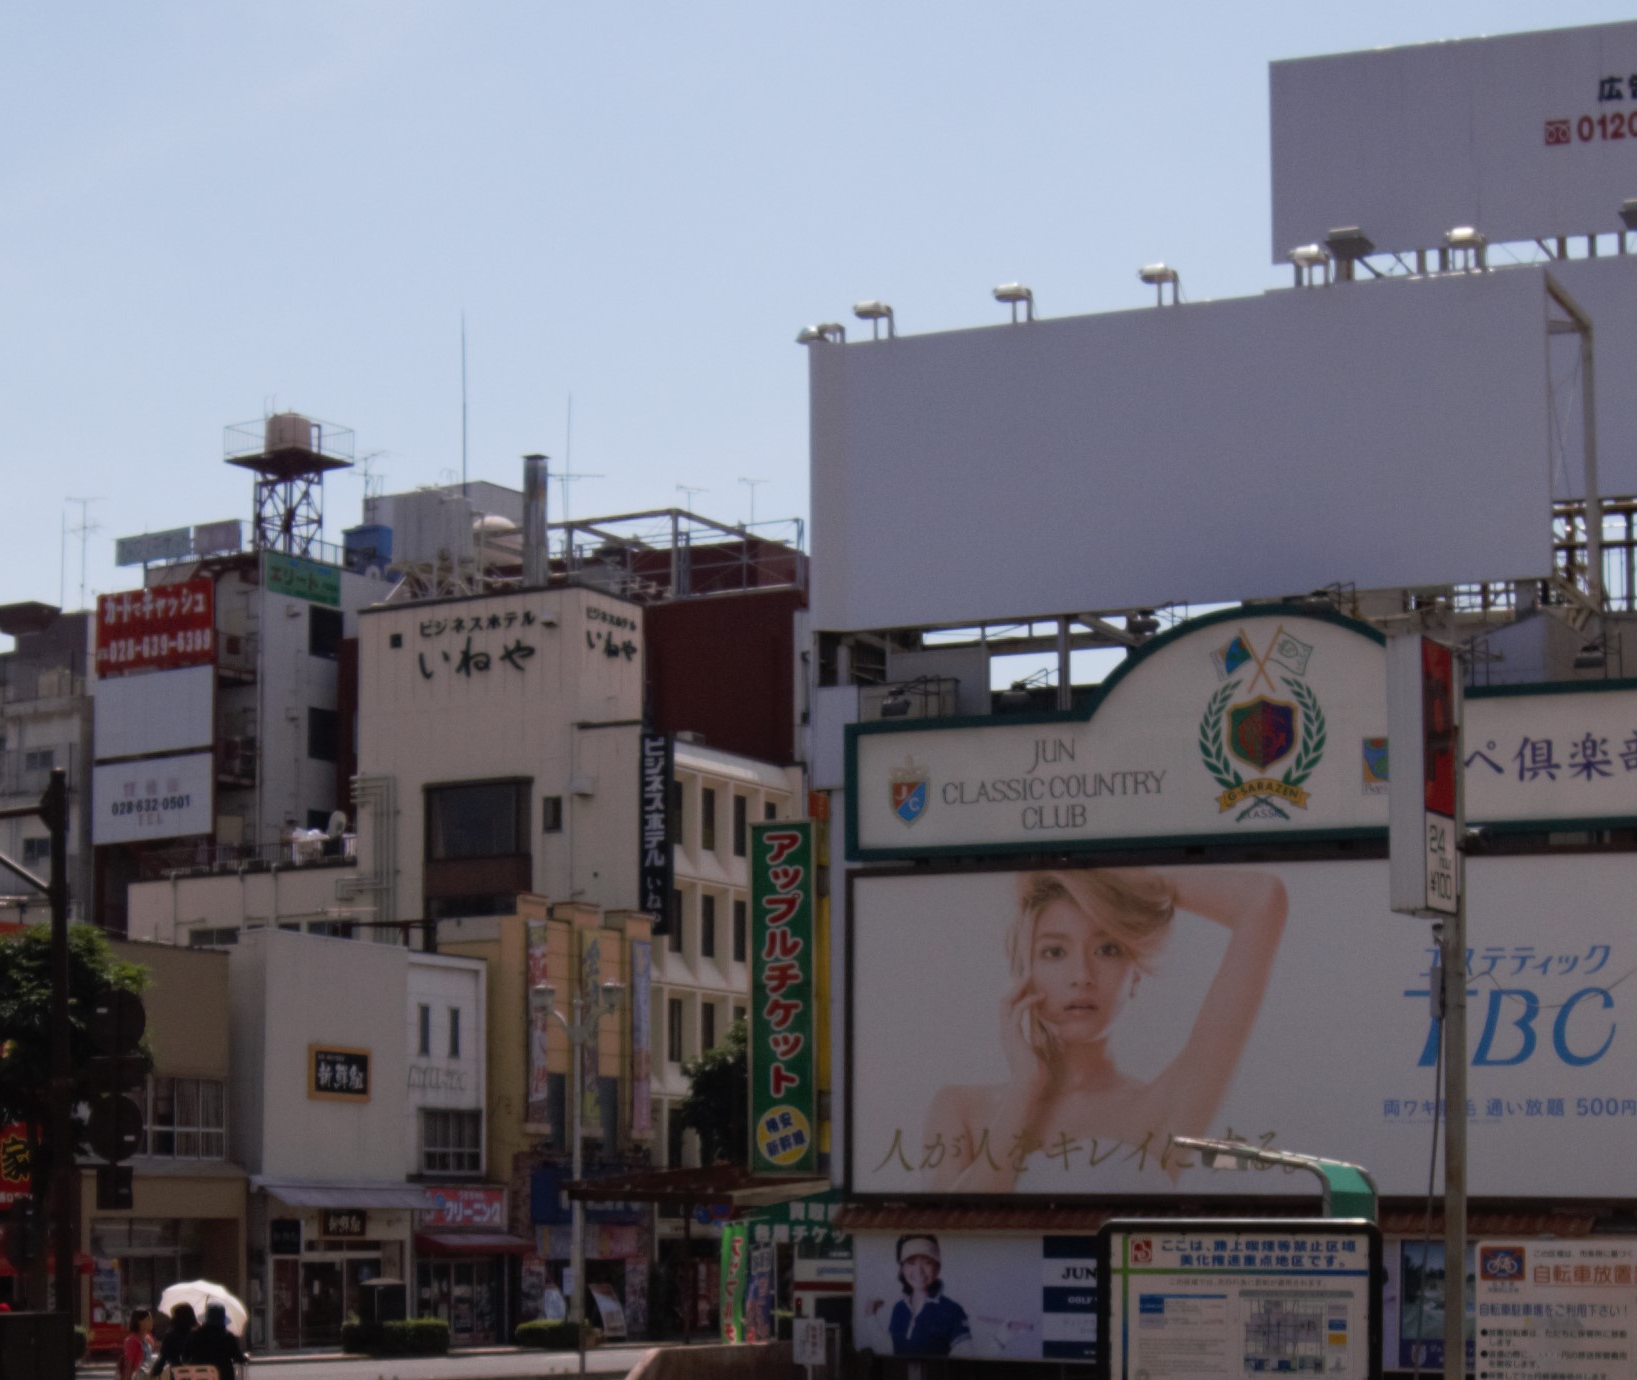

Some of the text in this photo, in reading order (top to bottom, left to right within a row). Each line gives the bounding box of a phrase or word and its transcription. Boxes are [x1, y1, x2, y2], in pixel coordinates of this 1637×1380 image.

[419, 611, 536, 637] ビジネスホテル
[419, 637, 535, 679] いねや
[586, 631, 637, 661] いねや
[1028, 739, 1076, 774] JUN
[644, 737, 665, 867] ビジネスホテル
[943, 771, 1166, 805] CLASSIC COUNTRY
[1022, 805, 1087, 829] CLUB
[762, 831, 804, 1095] アップルチケット
[1486, 1097, 1565, 1118] 通い放題
[1576, 1098, 1637, 1117] 500円
[765, 1111, 793, 1134] 格安
[767, 1130, 807, 1158] 新幹線
[444, 1199, 502, 1221] クリーニング
